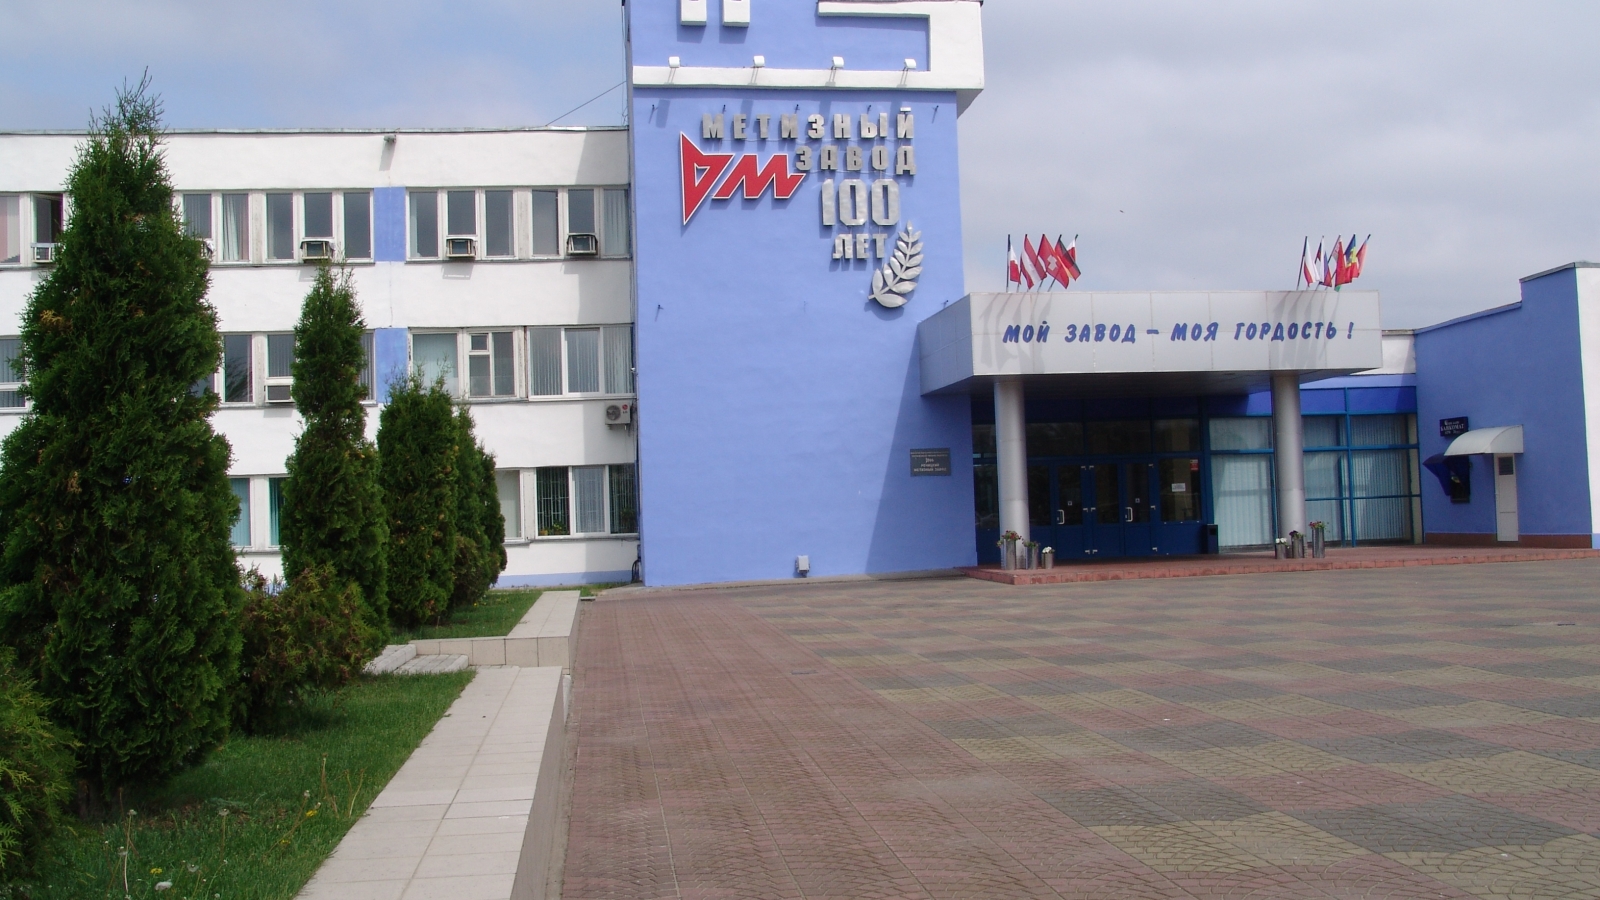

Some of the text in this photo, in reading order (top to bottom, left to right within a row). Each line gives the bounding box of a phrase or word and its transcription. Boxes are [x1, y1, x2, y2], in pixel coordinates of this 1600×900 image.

[703, 107, 914, 139] МЕТИЗНЫЙ
[795, 145, 917, 175] ЗАВОД
[822, 178, 900, 226] 100
[833, 233, 888, 259] ЛЕТ
[1002, 320, 1050, 343] МОЙ
[1064, 323, 1136, 344] ЗАВОД
[1170, 321, 1219, 342] МОЯ
[1233, 321, 1337, 342] ГОРДОСТЬ
